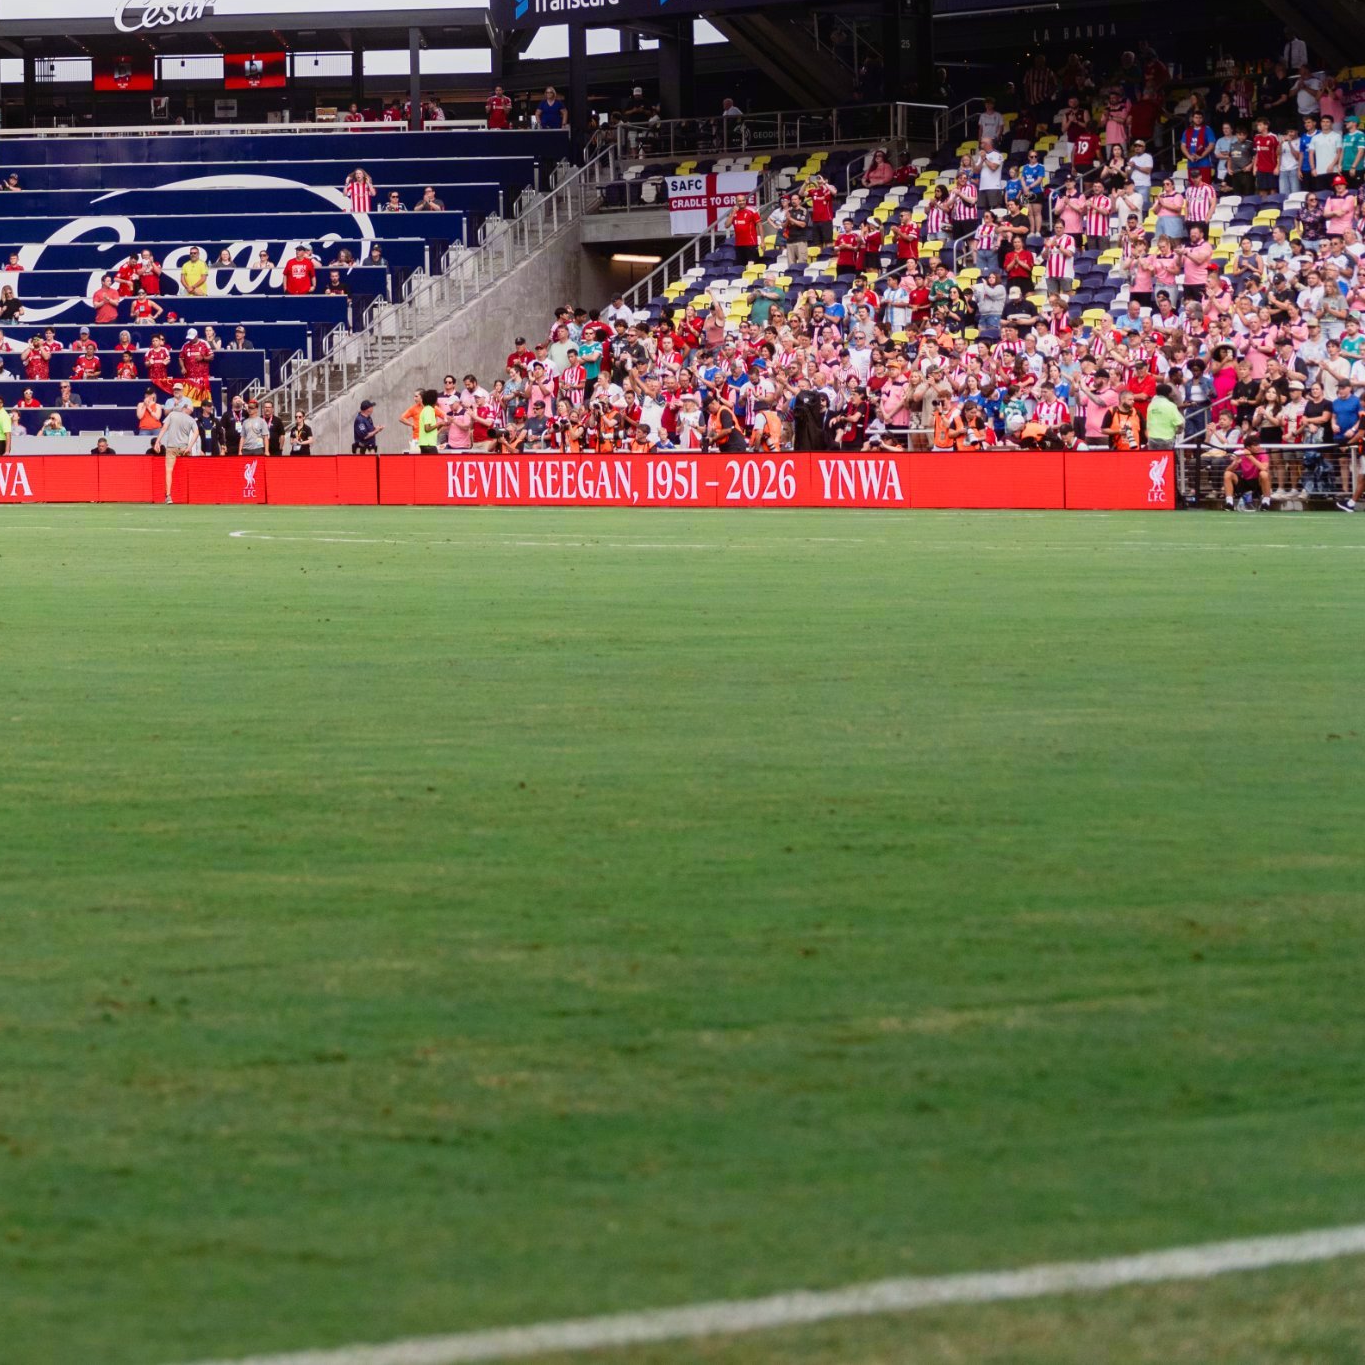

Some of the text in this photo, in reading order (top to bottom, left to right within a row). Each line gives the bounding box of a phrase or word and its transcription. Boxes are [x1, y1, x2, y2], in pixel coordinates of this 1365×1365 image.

[1078, 141, 1089, 155] 19
[671, 180, 702, 191] SAFC
[671, 194, 755, 209] CRADLE TO GRE
[447, 461, 520, 498] KEVIN
[528, 460, 639, 505] KEEGAN,
[647, 460, 698, 500] 1951
[725, 459, 796, 500] 2026
[818, 459, 904, 501] YNWA
